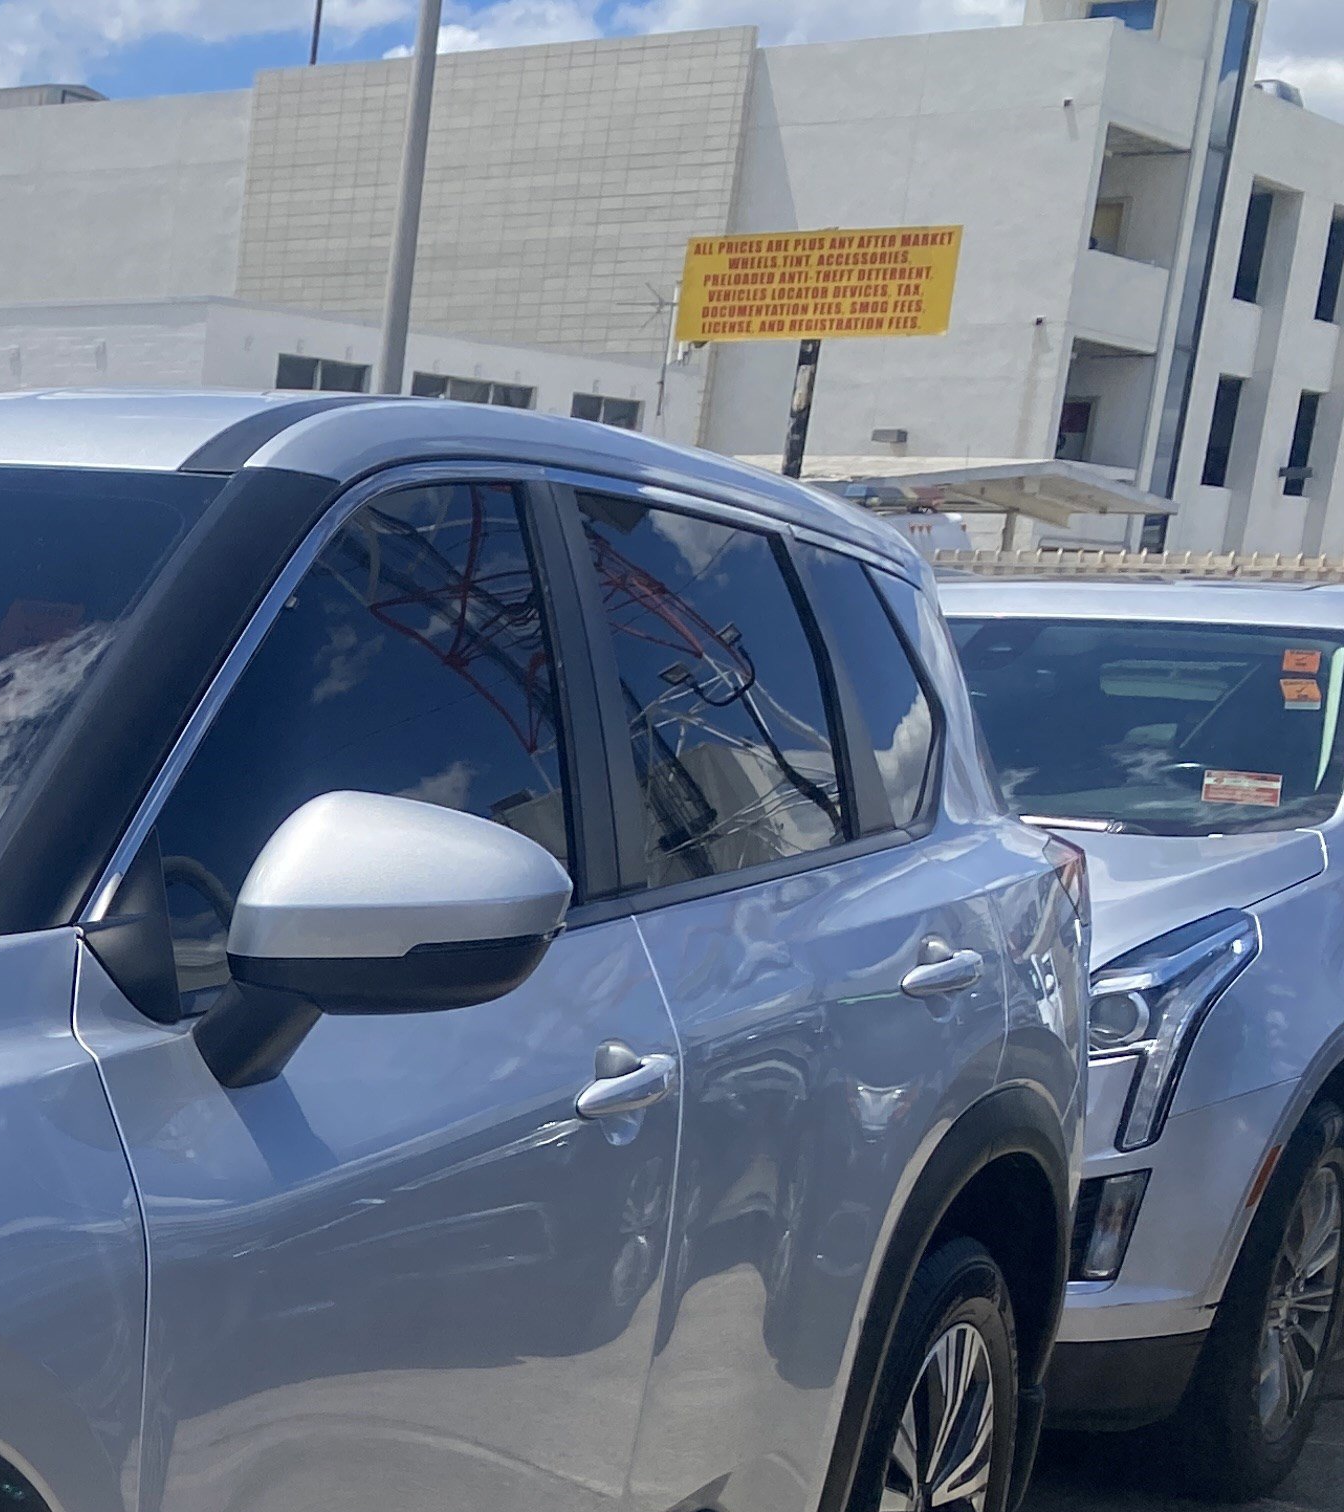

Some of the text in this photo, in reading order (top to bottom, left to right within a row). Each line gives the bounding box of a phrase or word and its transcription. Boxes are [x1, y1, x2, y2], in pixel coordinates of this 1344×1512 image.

[694, 232, 954, 255] ALL PRICES ARE PLUS ANY AFTER MARKET
[703, 272, 775, 286] PRELOADED
[708, 288, 767, 302] VEHICLES
[771, 286, 828, 301] LOCATOR
[702, 303, 809, 318] DOCUMENTATION
[850, 301, 889, 314] SMOG
[759, 320, 785, 332] AND
[789, 317, 884, 332] REGISTRATION
